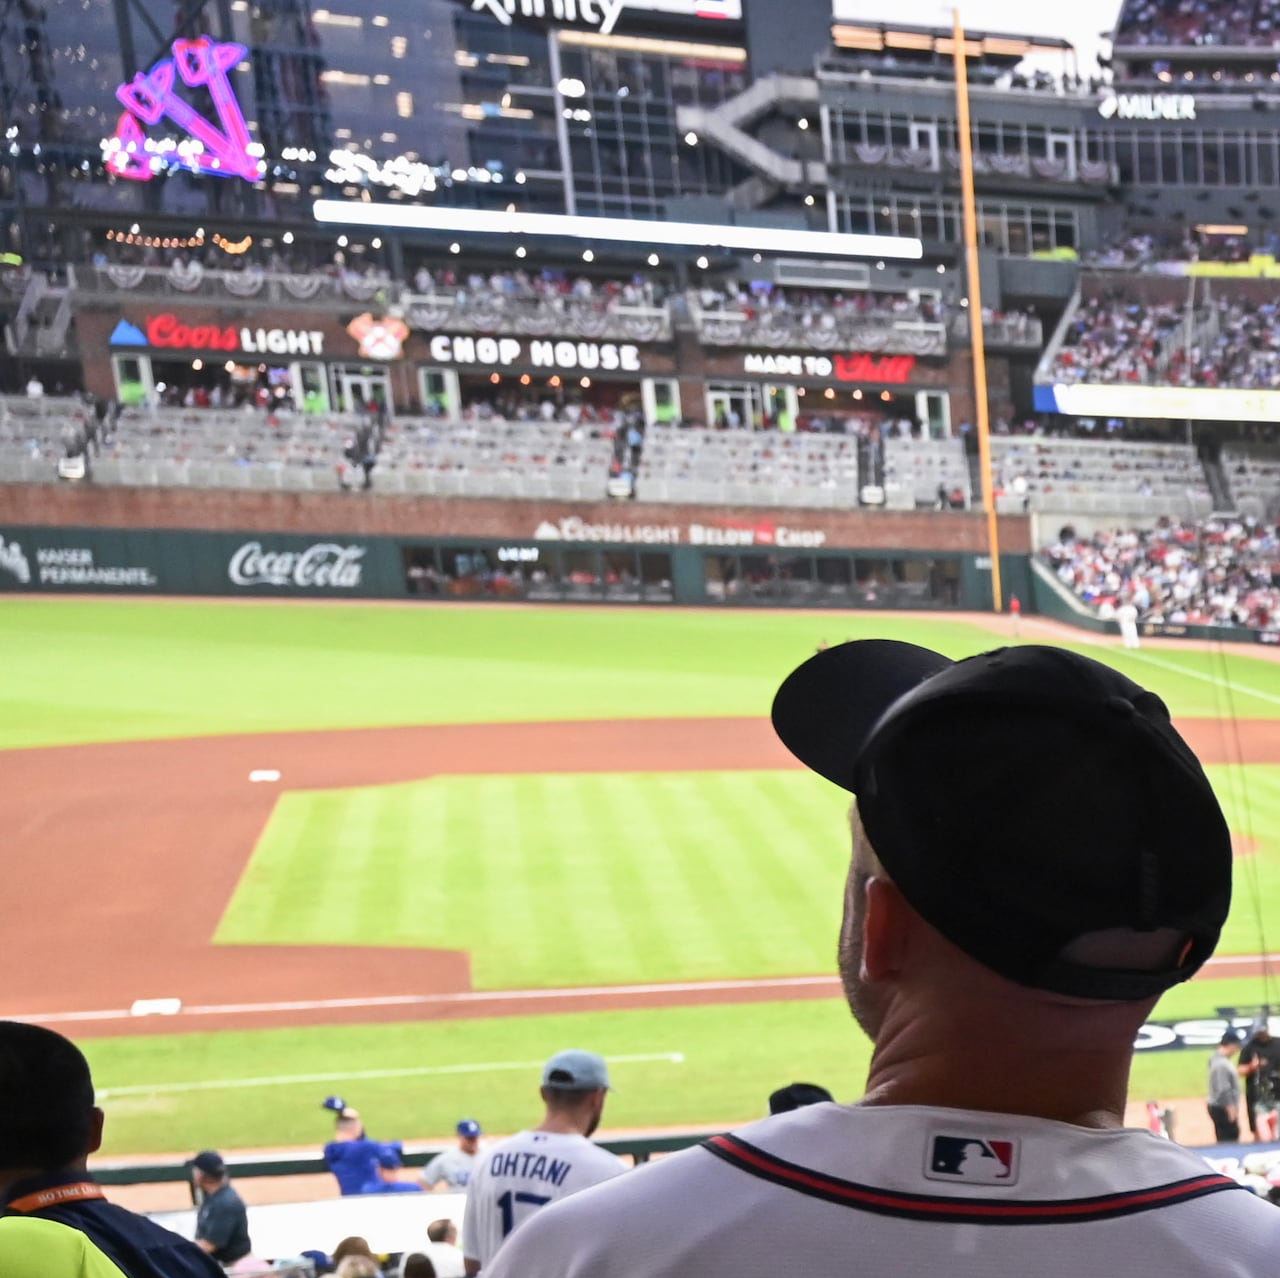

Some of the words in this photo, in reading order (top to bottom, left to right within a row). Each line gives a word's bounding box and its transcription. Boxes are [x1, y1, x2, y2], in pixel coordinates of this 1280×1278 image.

[147, 313, 237, 350] Coors
[240, 328, 324, 354] LIGHT
[430, 336, 520, 365] CHOP
[530, 340, 640, 370] HOUSE
[804, 356, 833, 376] TO
[490, 1152, 572, 1186] OHTANI
